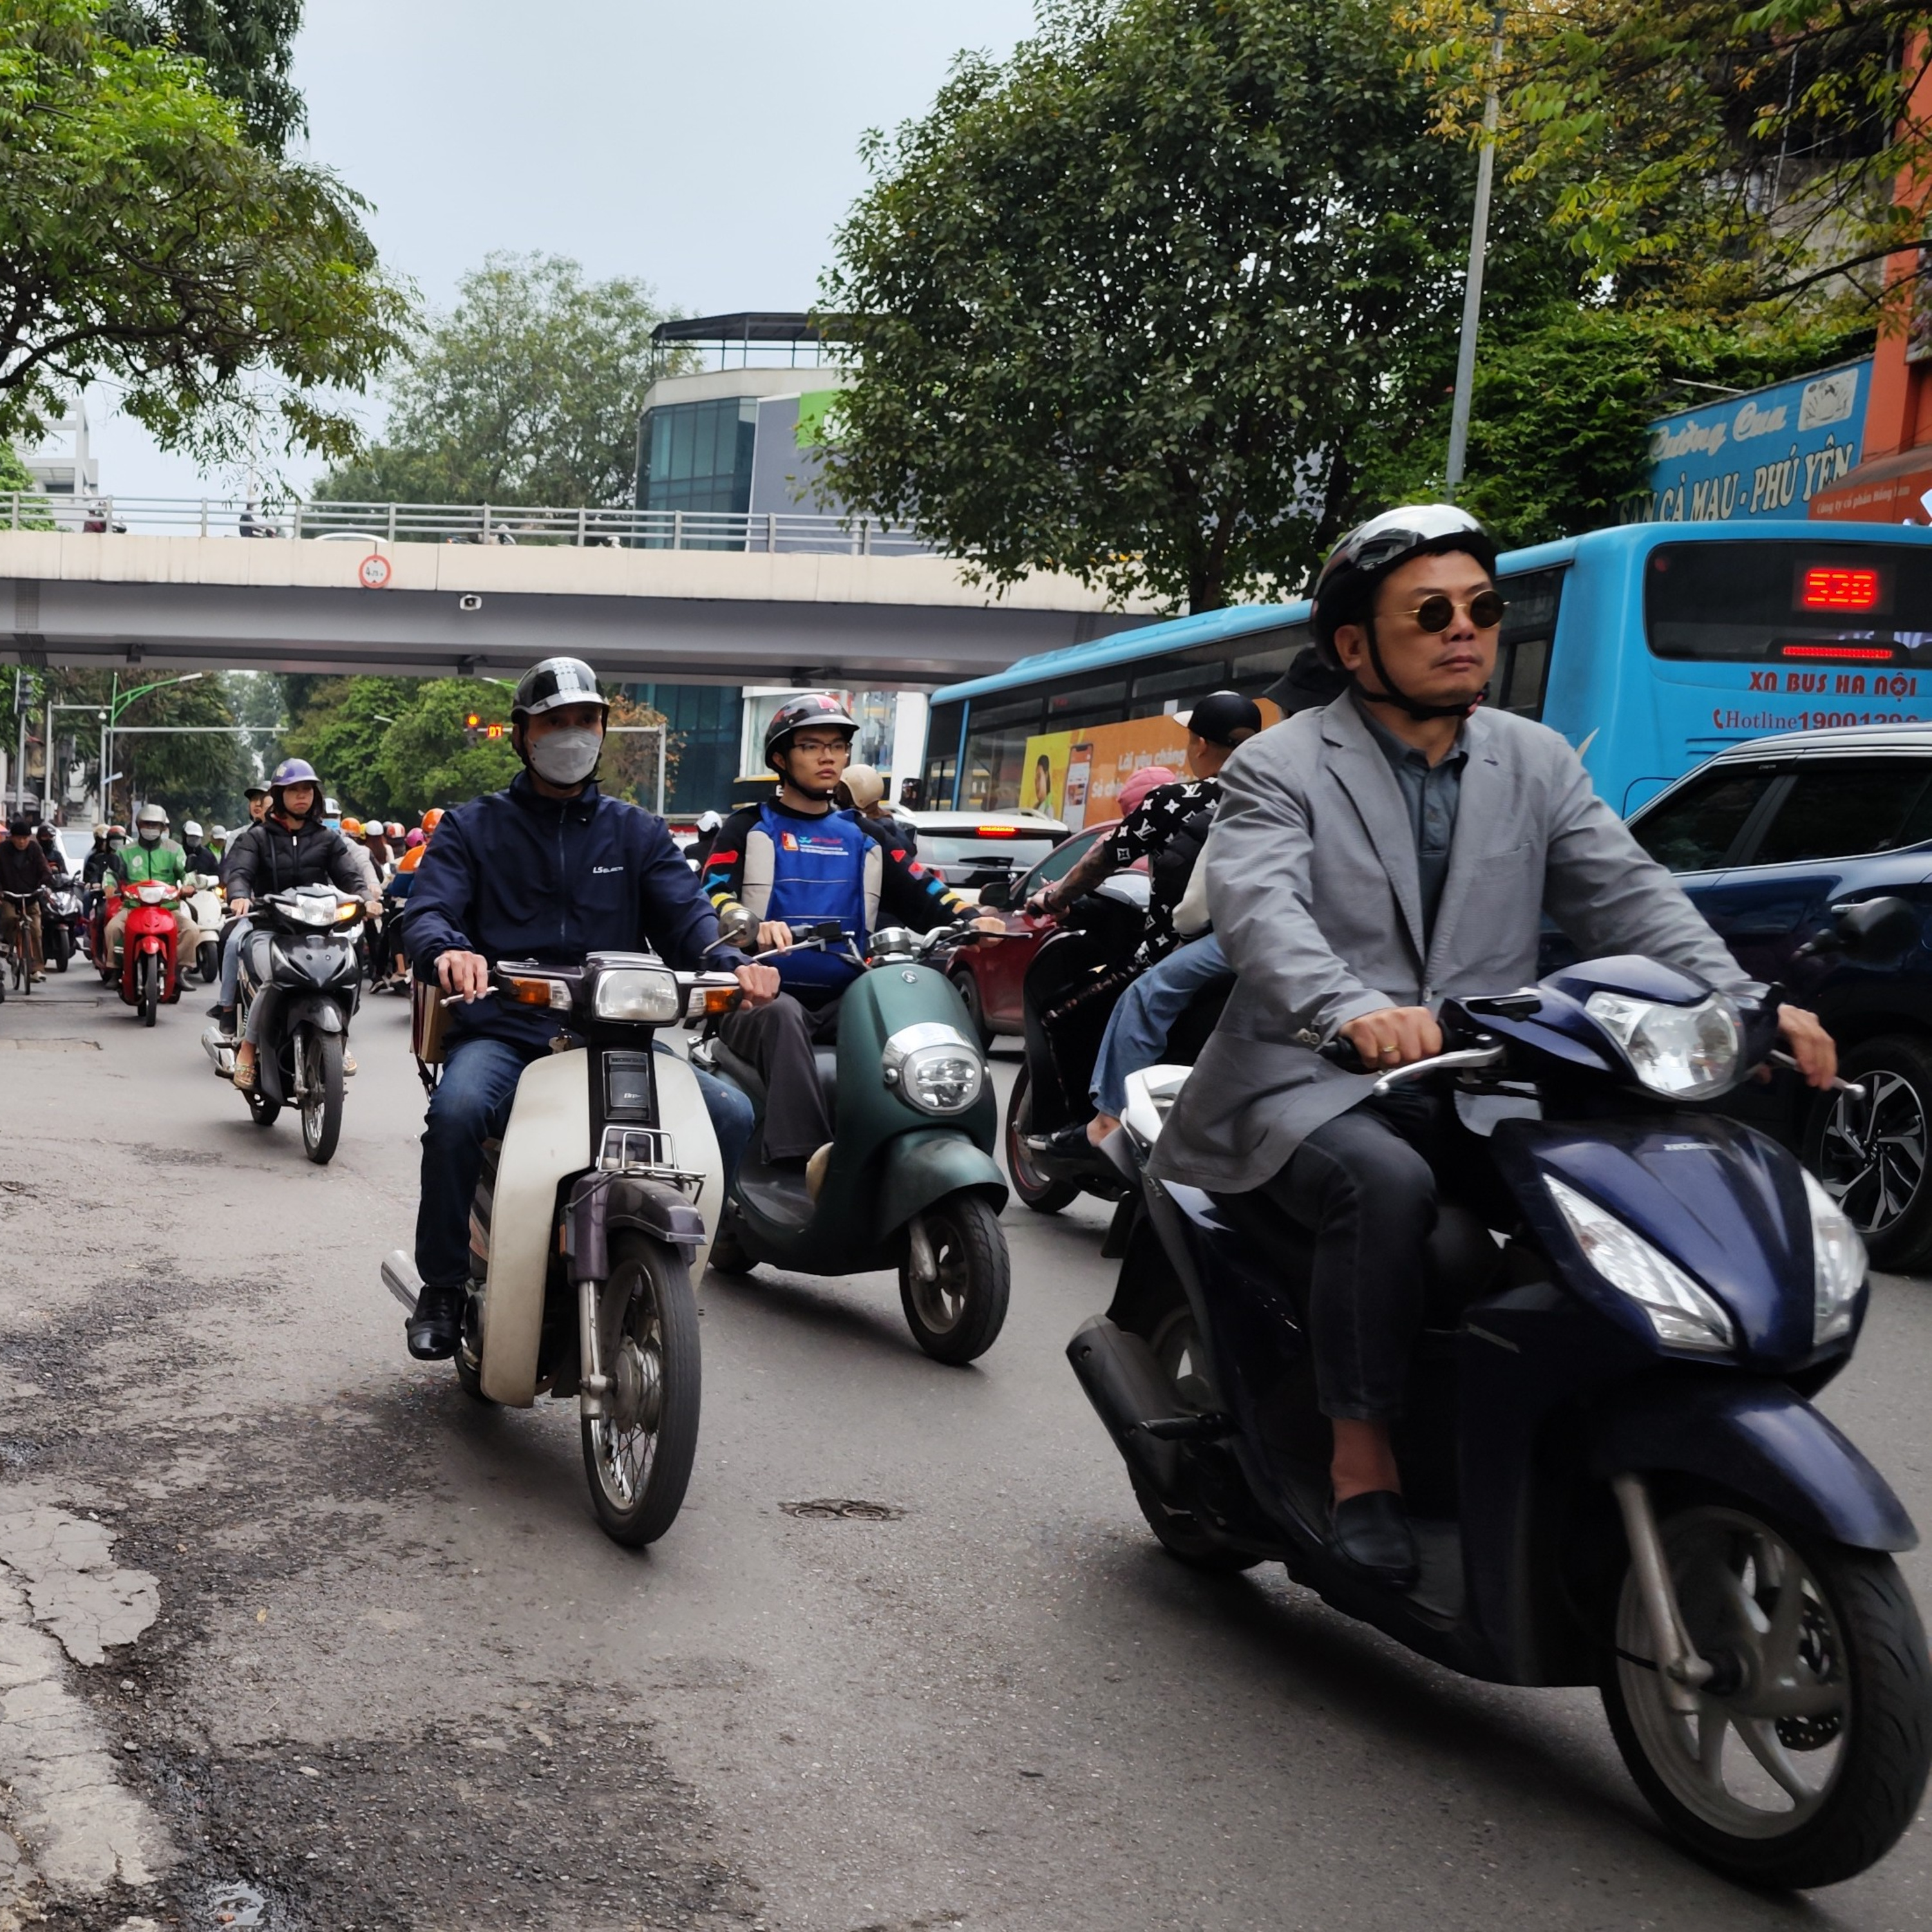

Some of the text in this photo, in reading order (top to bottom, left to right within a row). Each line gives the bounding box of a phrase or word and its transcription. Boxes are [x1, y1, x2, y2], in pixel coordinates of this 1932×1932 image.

[1690, 473, 1739, 521] MAU
[1749, 443, 1800, 513] PHÚ
[1803, 432, 1854, 502] YÊN
[1786, 673, 1827, 693] BUS
[1725, 710, 1797, 730] Hotline
